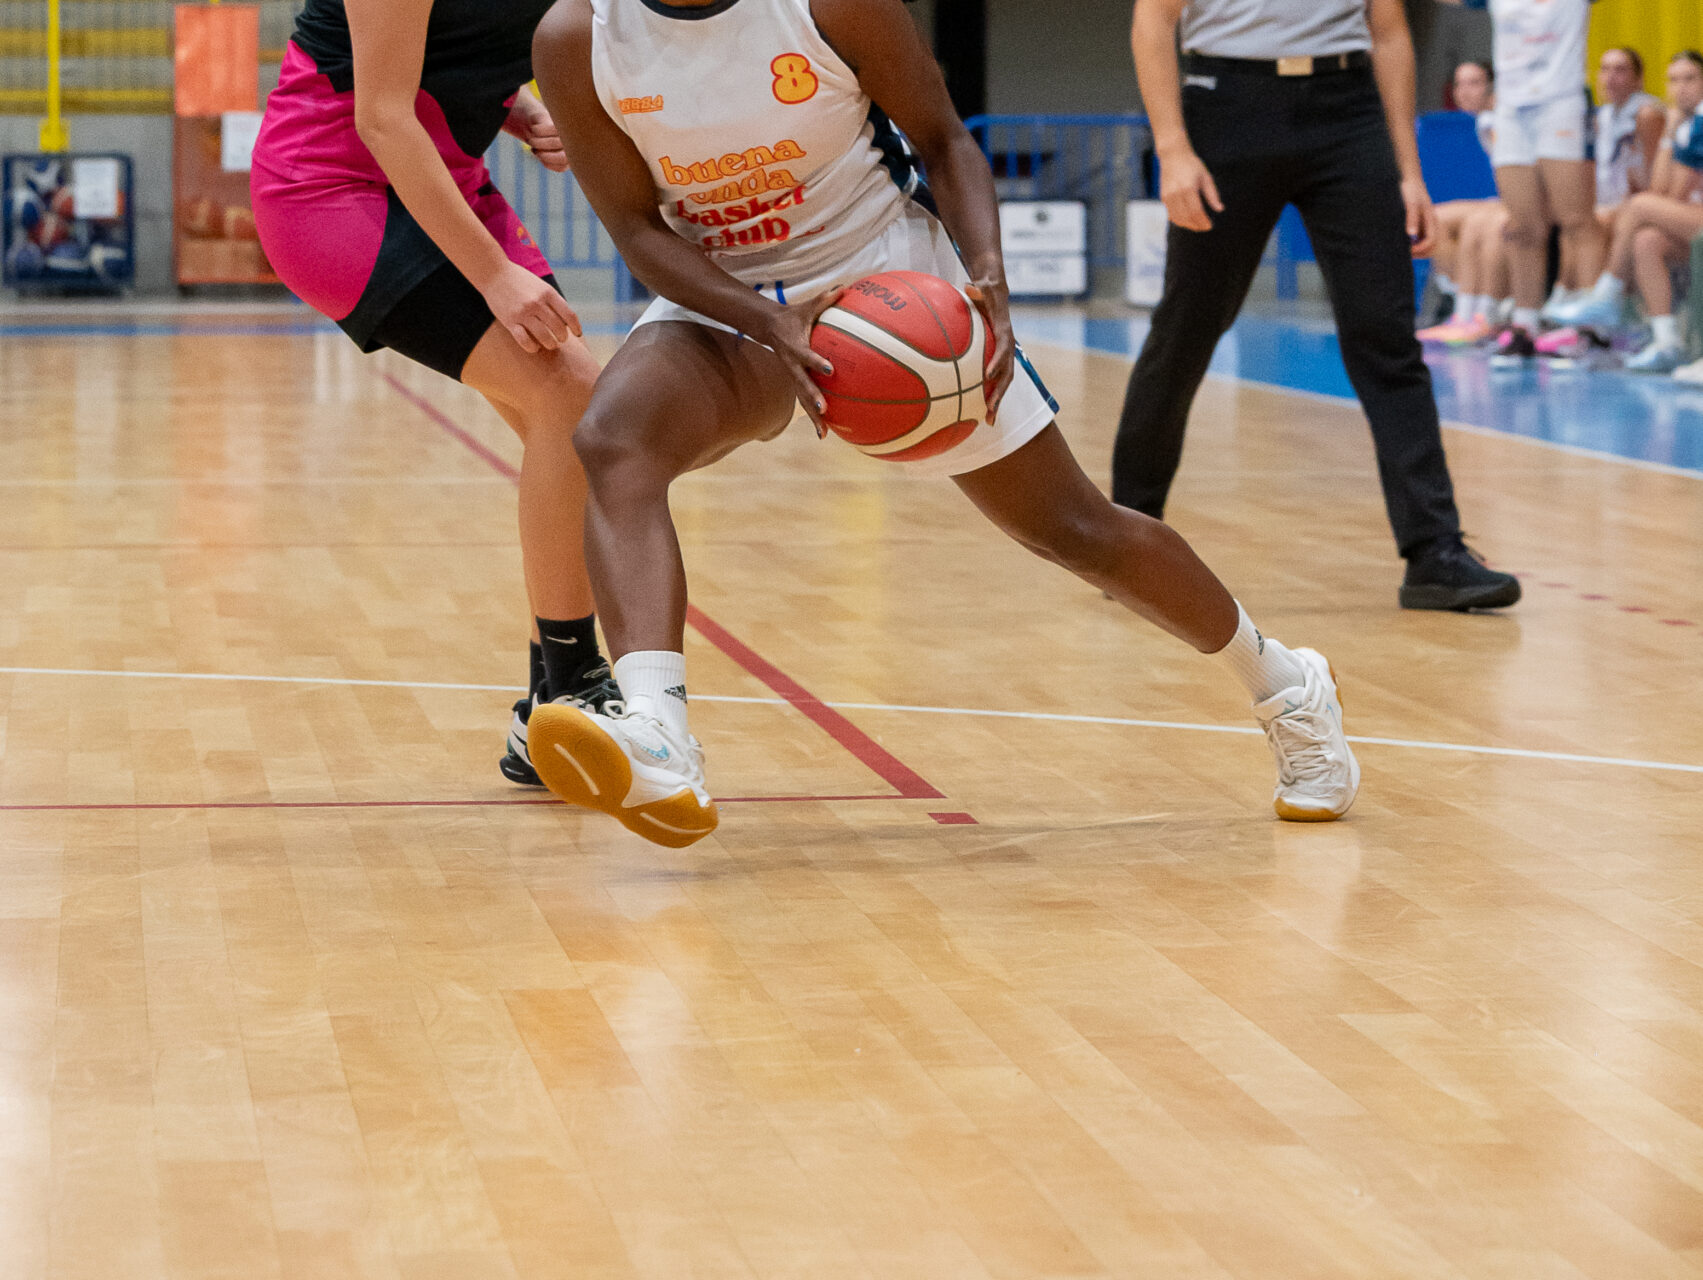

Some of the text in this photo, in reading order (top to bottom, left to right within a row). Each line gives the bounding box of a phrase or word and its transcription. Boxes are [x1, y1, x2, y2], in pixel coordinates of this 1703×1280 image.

[770, 52, 819, 105] 8
[658, 139, 807, 186] buena
[702, 216, 791, 248] club
[855, 280, 907, 311] molte
